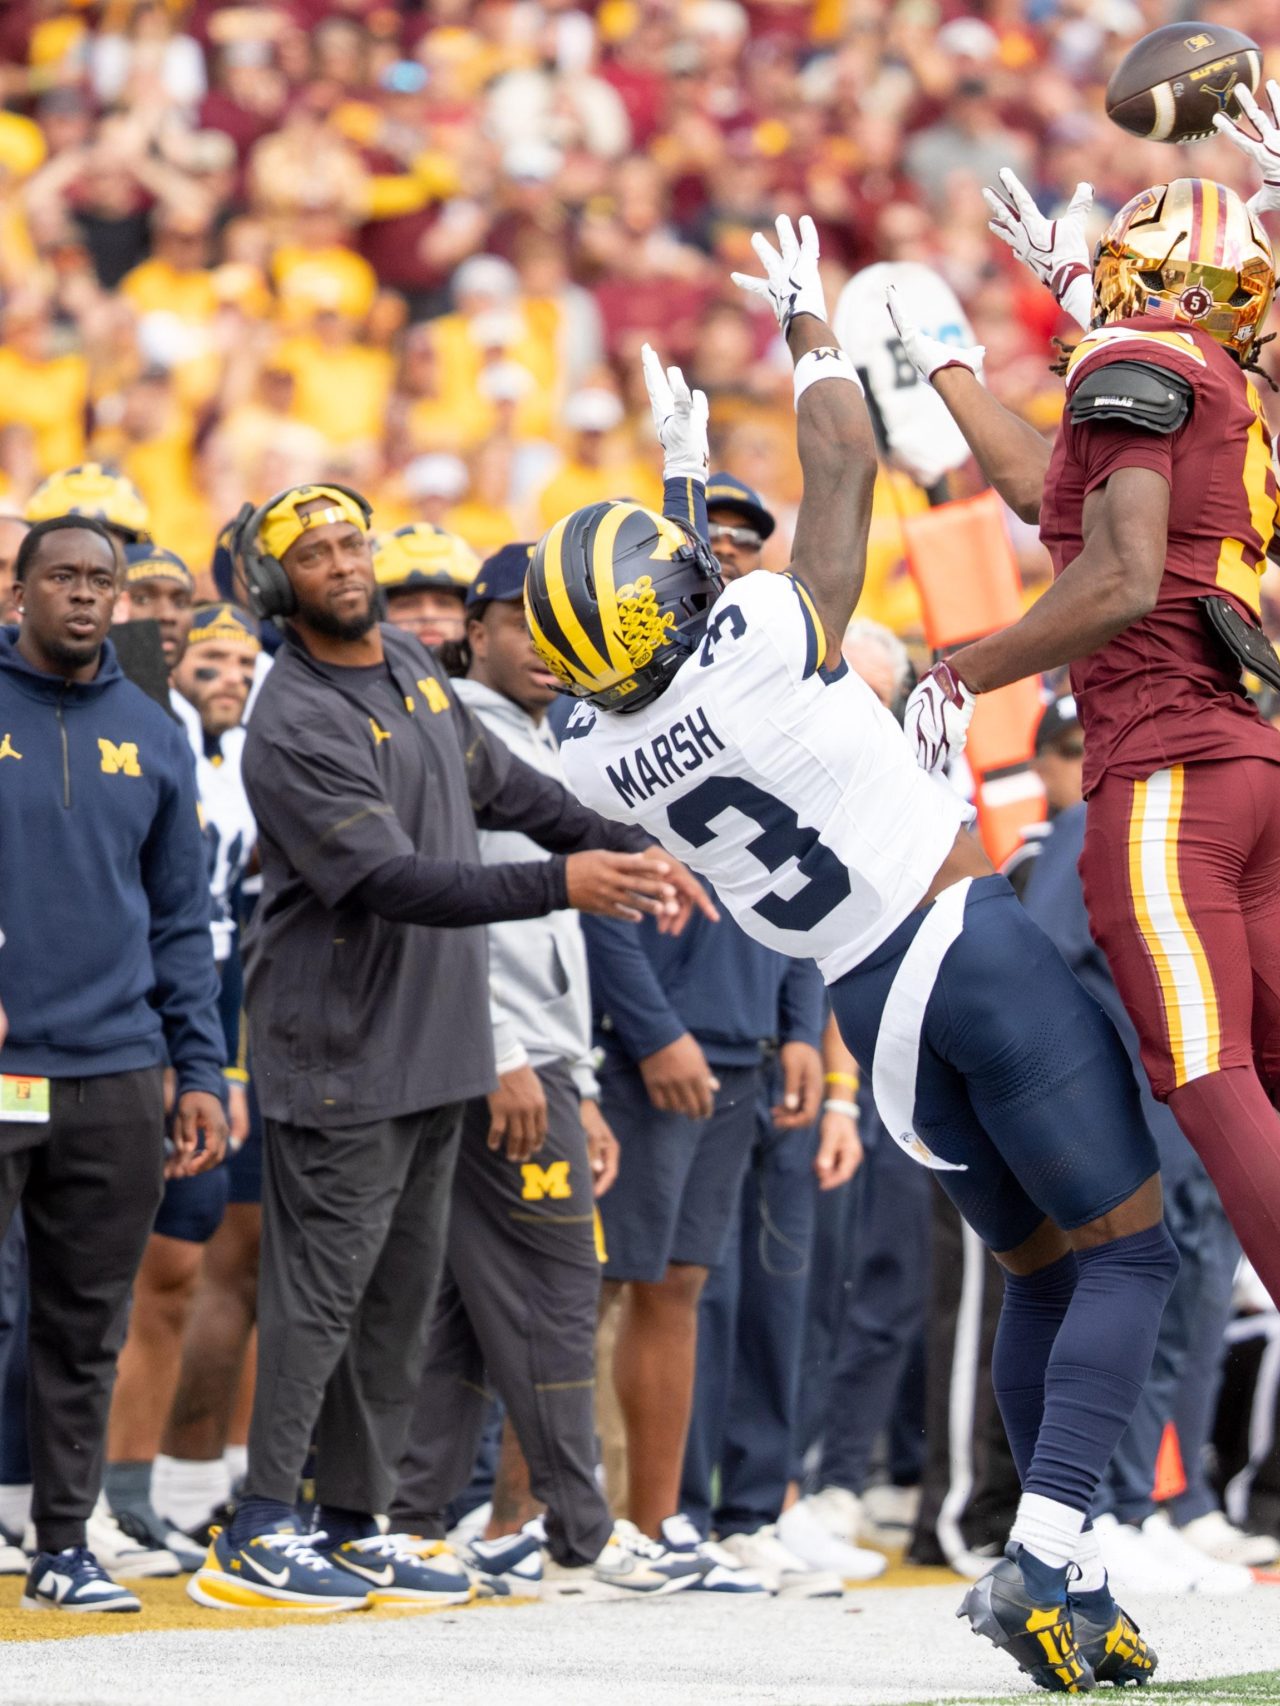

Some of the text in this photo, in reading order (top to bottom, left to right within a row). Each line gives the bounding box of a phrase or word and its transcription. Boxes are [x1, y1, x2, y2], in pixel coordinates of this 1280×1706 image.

[1190, 296, 1200, 311] 5
[98, 738, 143, 777] M
[605, 706, 725, 809] MARSH
[667, 776, 852, 932] 3
[521, 1161, 571, 1199] M
